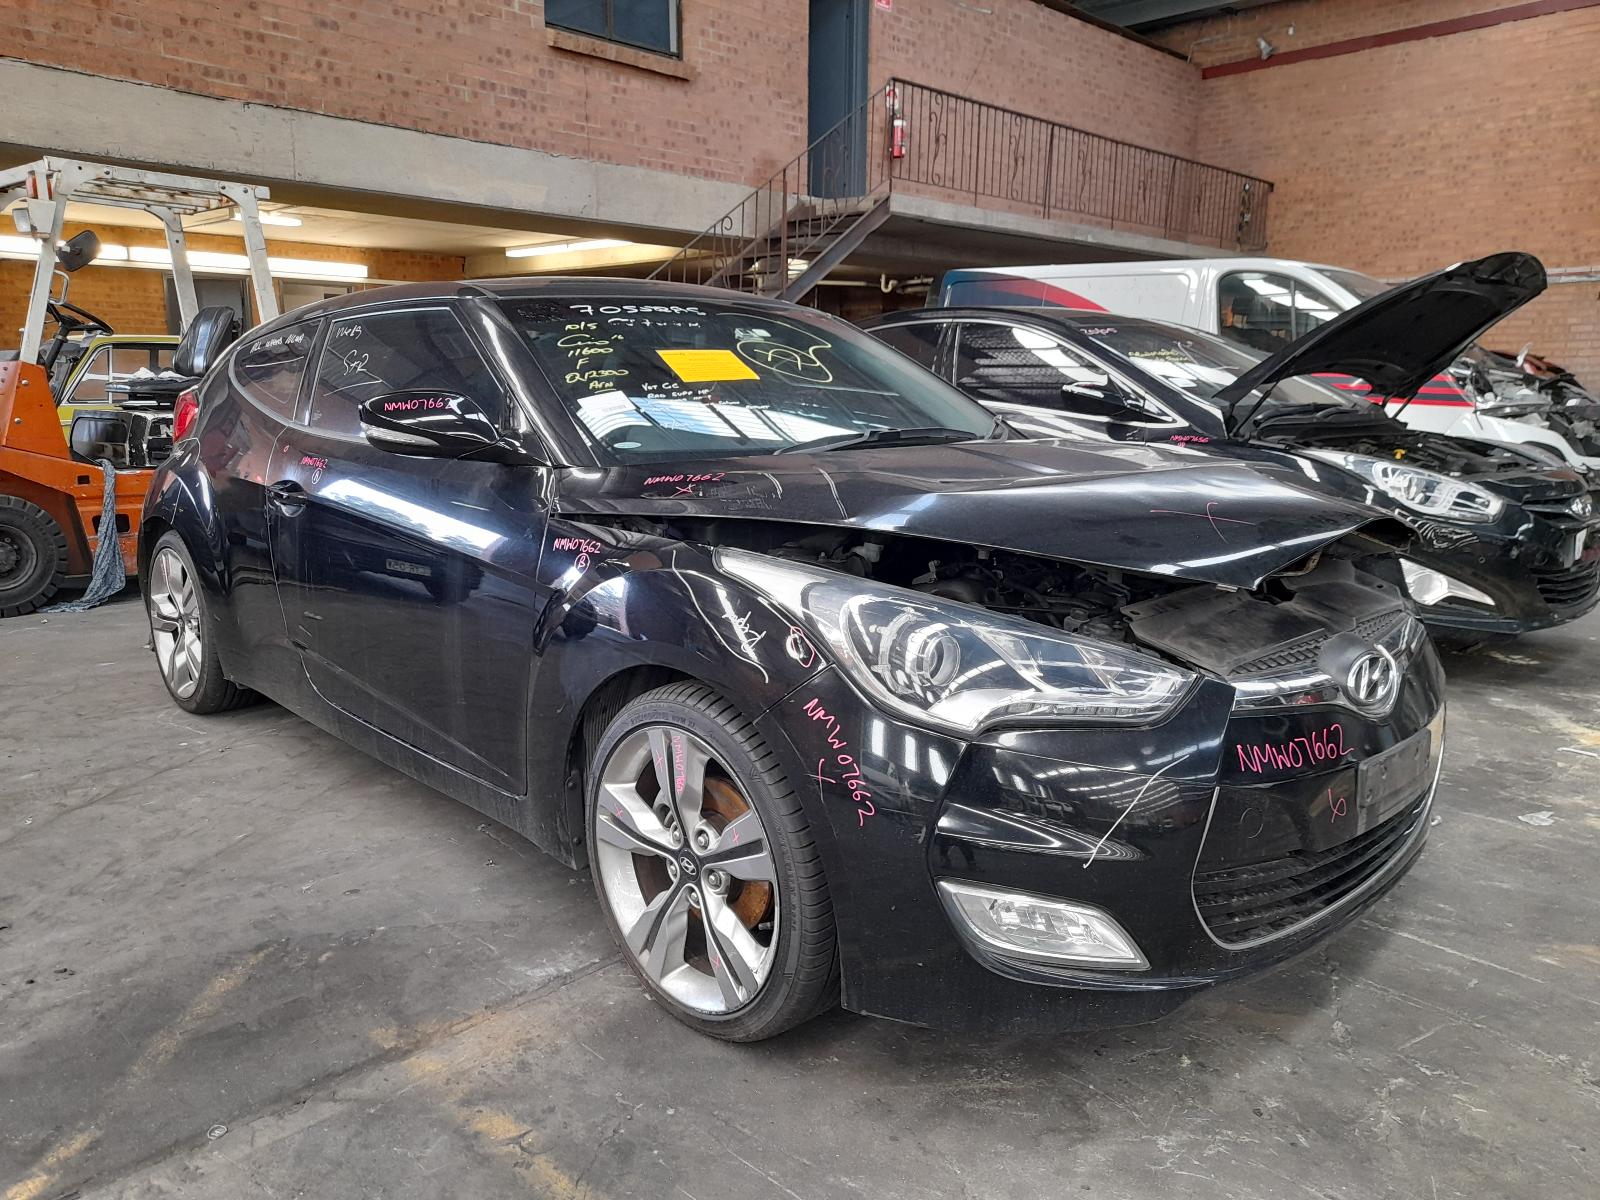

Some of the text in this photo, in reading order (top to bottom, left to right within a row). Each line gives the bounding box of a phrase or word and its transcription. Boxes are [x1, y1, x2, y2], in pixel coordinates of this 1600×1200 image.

[384, 397, 453, 412] NMW07662
[643, 472, 728, 486] NMW07662
[552, 537, 602, 554] NMW07662
[1236, 723, 1355, 774] NMW07662
[803, 698, 875, 827] NMW07662
